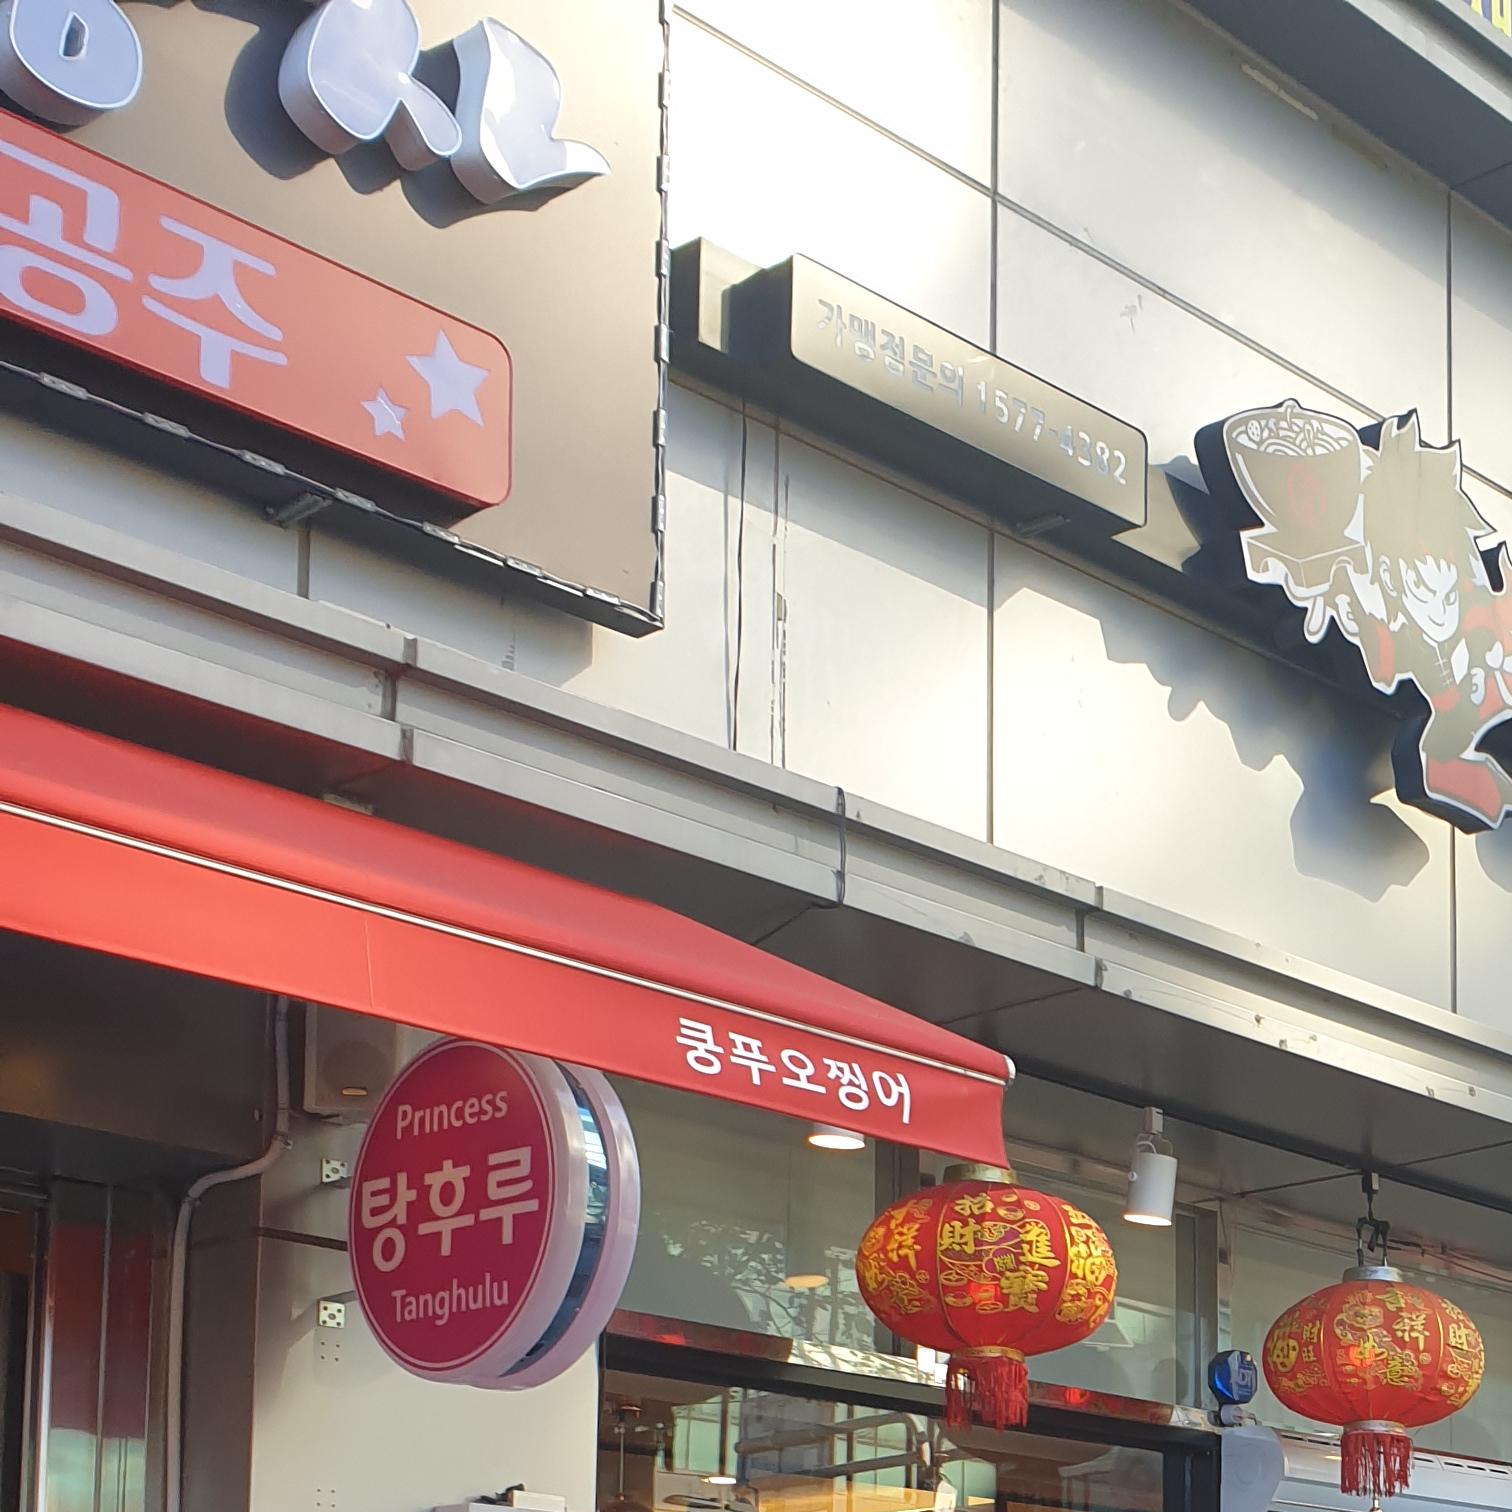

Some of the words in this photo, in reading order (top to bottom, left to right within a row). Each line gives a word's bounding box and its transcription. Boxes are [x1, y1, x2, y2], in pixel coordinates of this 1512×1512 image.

[0, 140, 288, 390] 공주
[816, 298, 965, 407] 가맹점문의
[976, 380, 1128, 486] 1577-4382
[396, 1090, 509, 1141] Princess
[676, 1017, 912, 1124] 쿵푸오찡어
[360, 1146, 540, 1272] 탕후루
[391, 1273, 510, 1327] Tanghulu
